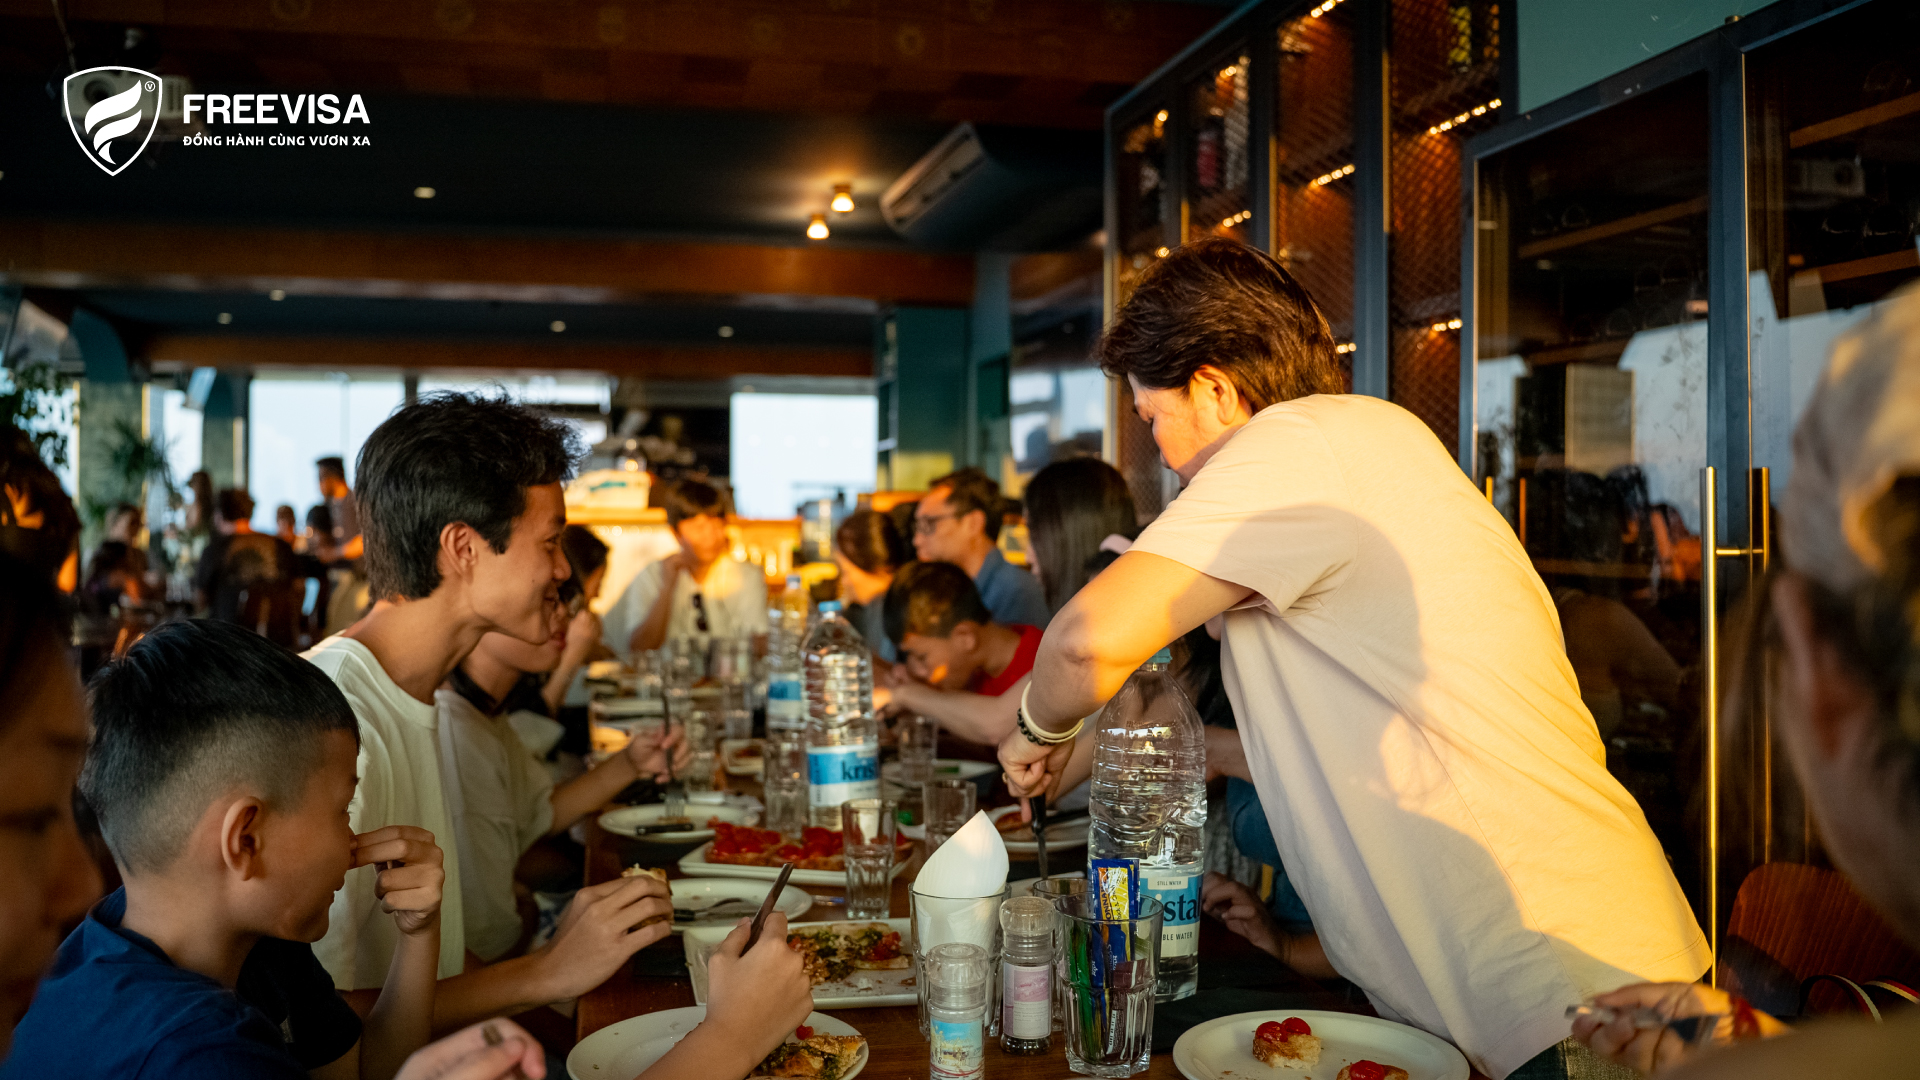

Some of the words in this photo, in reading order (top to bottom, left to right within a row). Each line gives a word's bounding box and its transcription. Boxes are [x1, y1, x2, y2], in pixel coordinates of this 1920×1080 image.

[1155, 887, 1201, 922] stal
[1162, 933, 1174, 941] BLE
[1176, 931, 1193, 940] WATER
